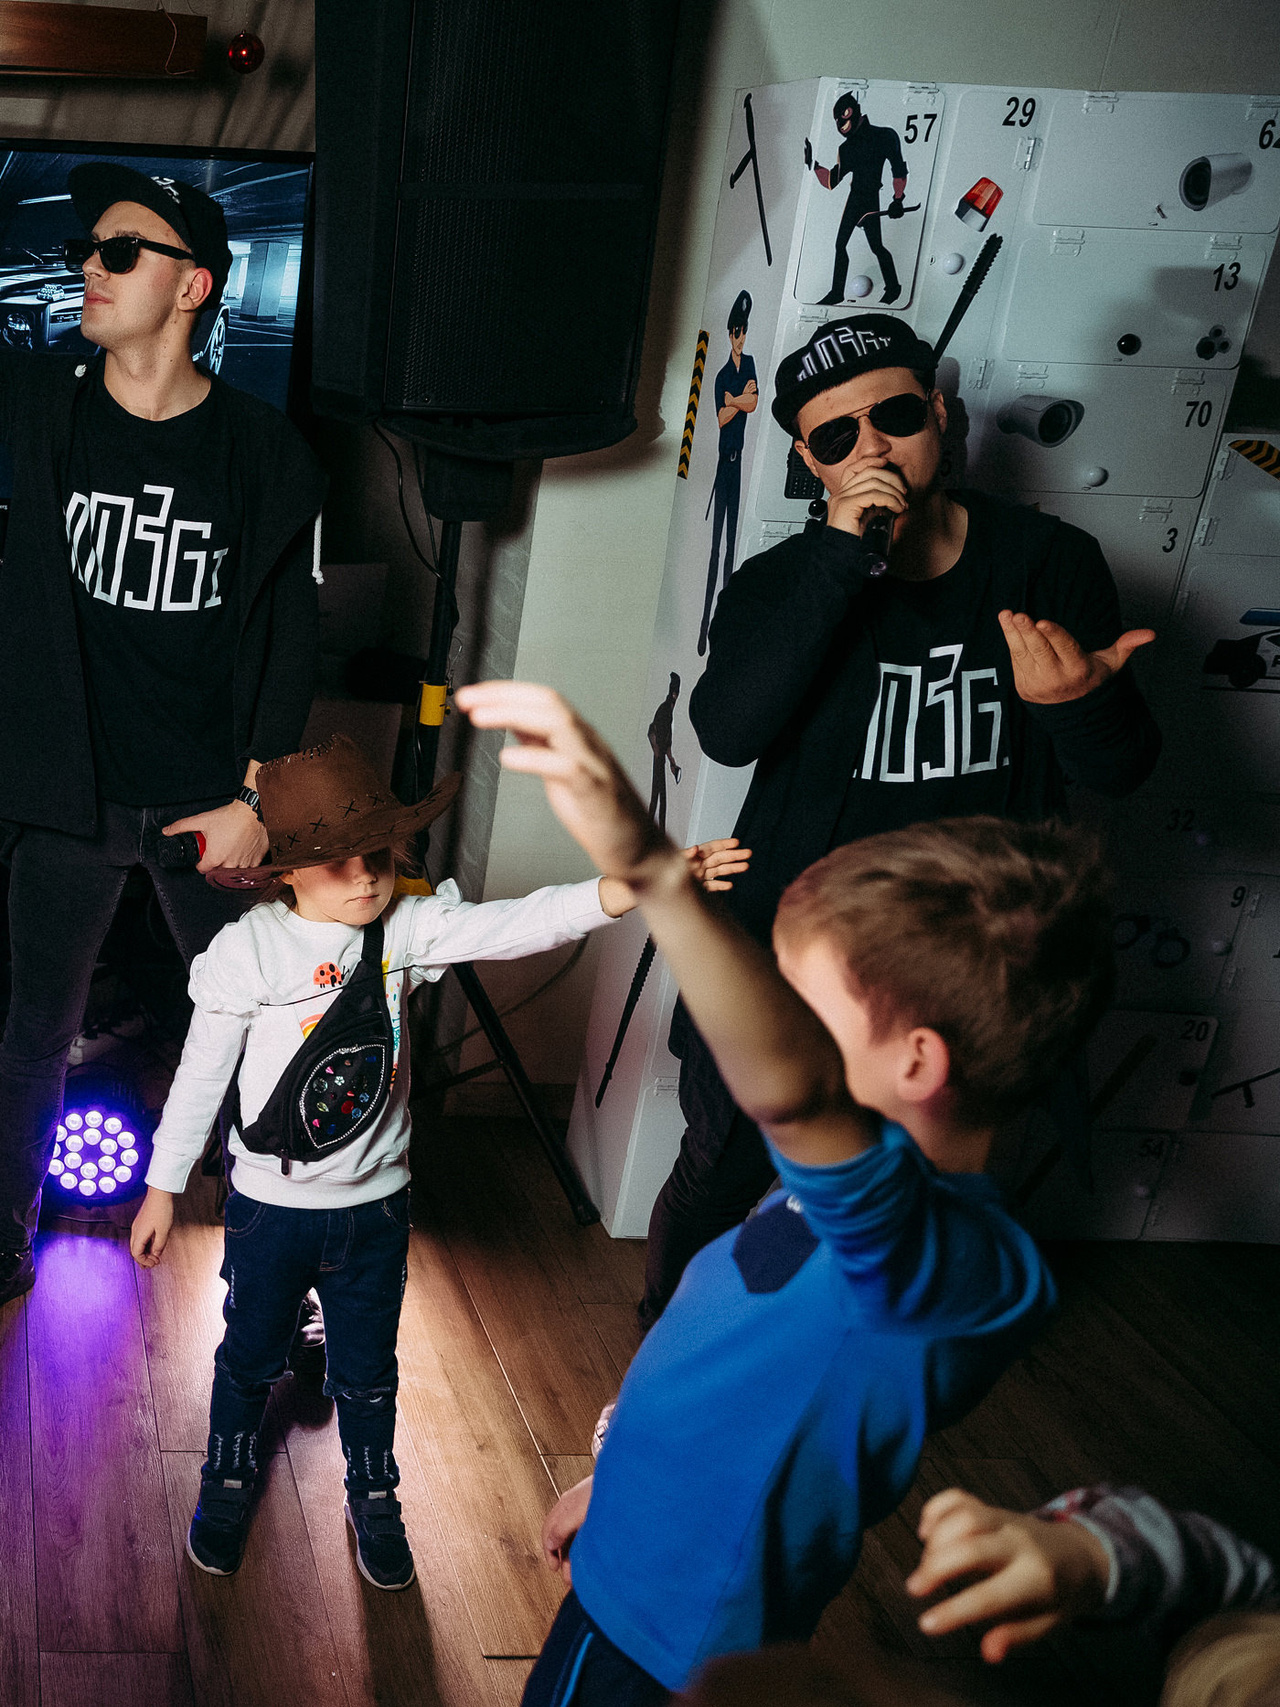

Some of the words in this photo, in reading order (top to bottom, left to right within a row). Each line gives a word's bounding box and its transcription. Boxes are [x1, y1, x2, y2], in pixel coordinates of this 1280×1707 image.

[1002, 96, 1036, 128] 29
[903, 113, 938, 144] 57
[1259, 119, 1280, 149] 6
[1213, 262, 1241, 292] 13
[1185, 400, 1213, 428] 70
[1162, 527, 1178, 553] 3
[1167, 808, 1195, 832] 32
[1230, 886, 1246, 908] 9
[1180, 1019, 1209, 1042] 20
